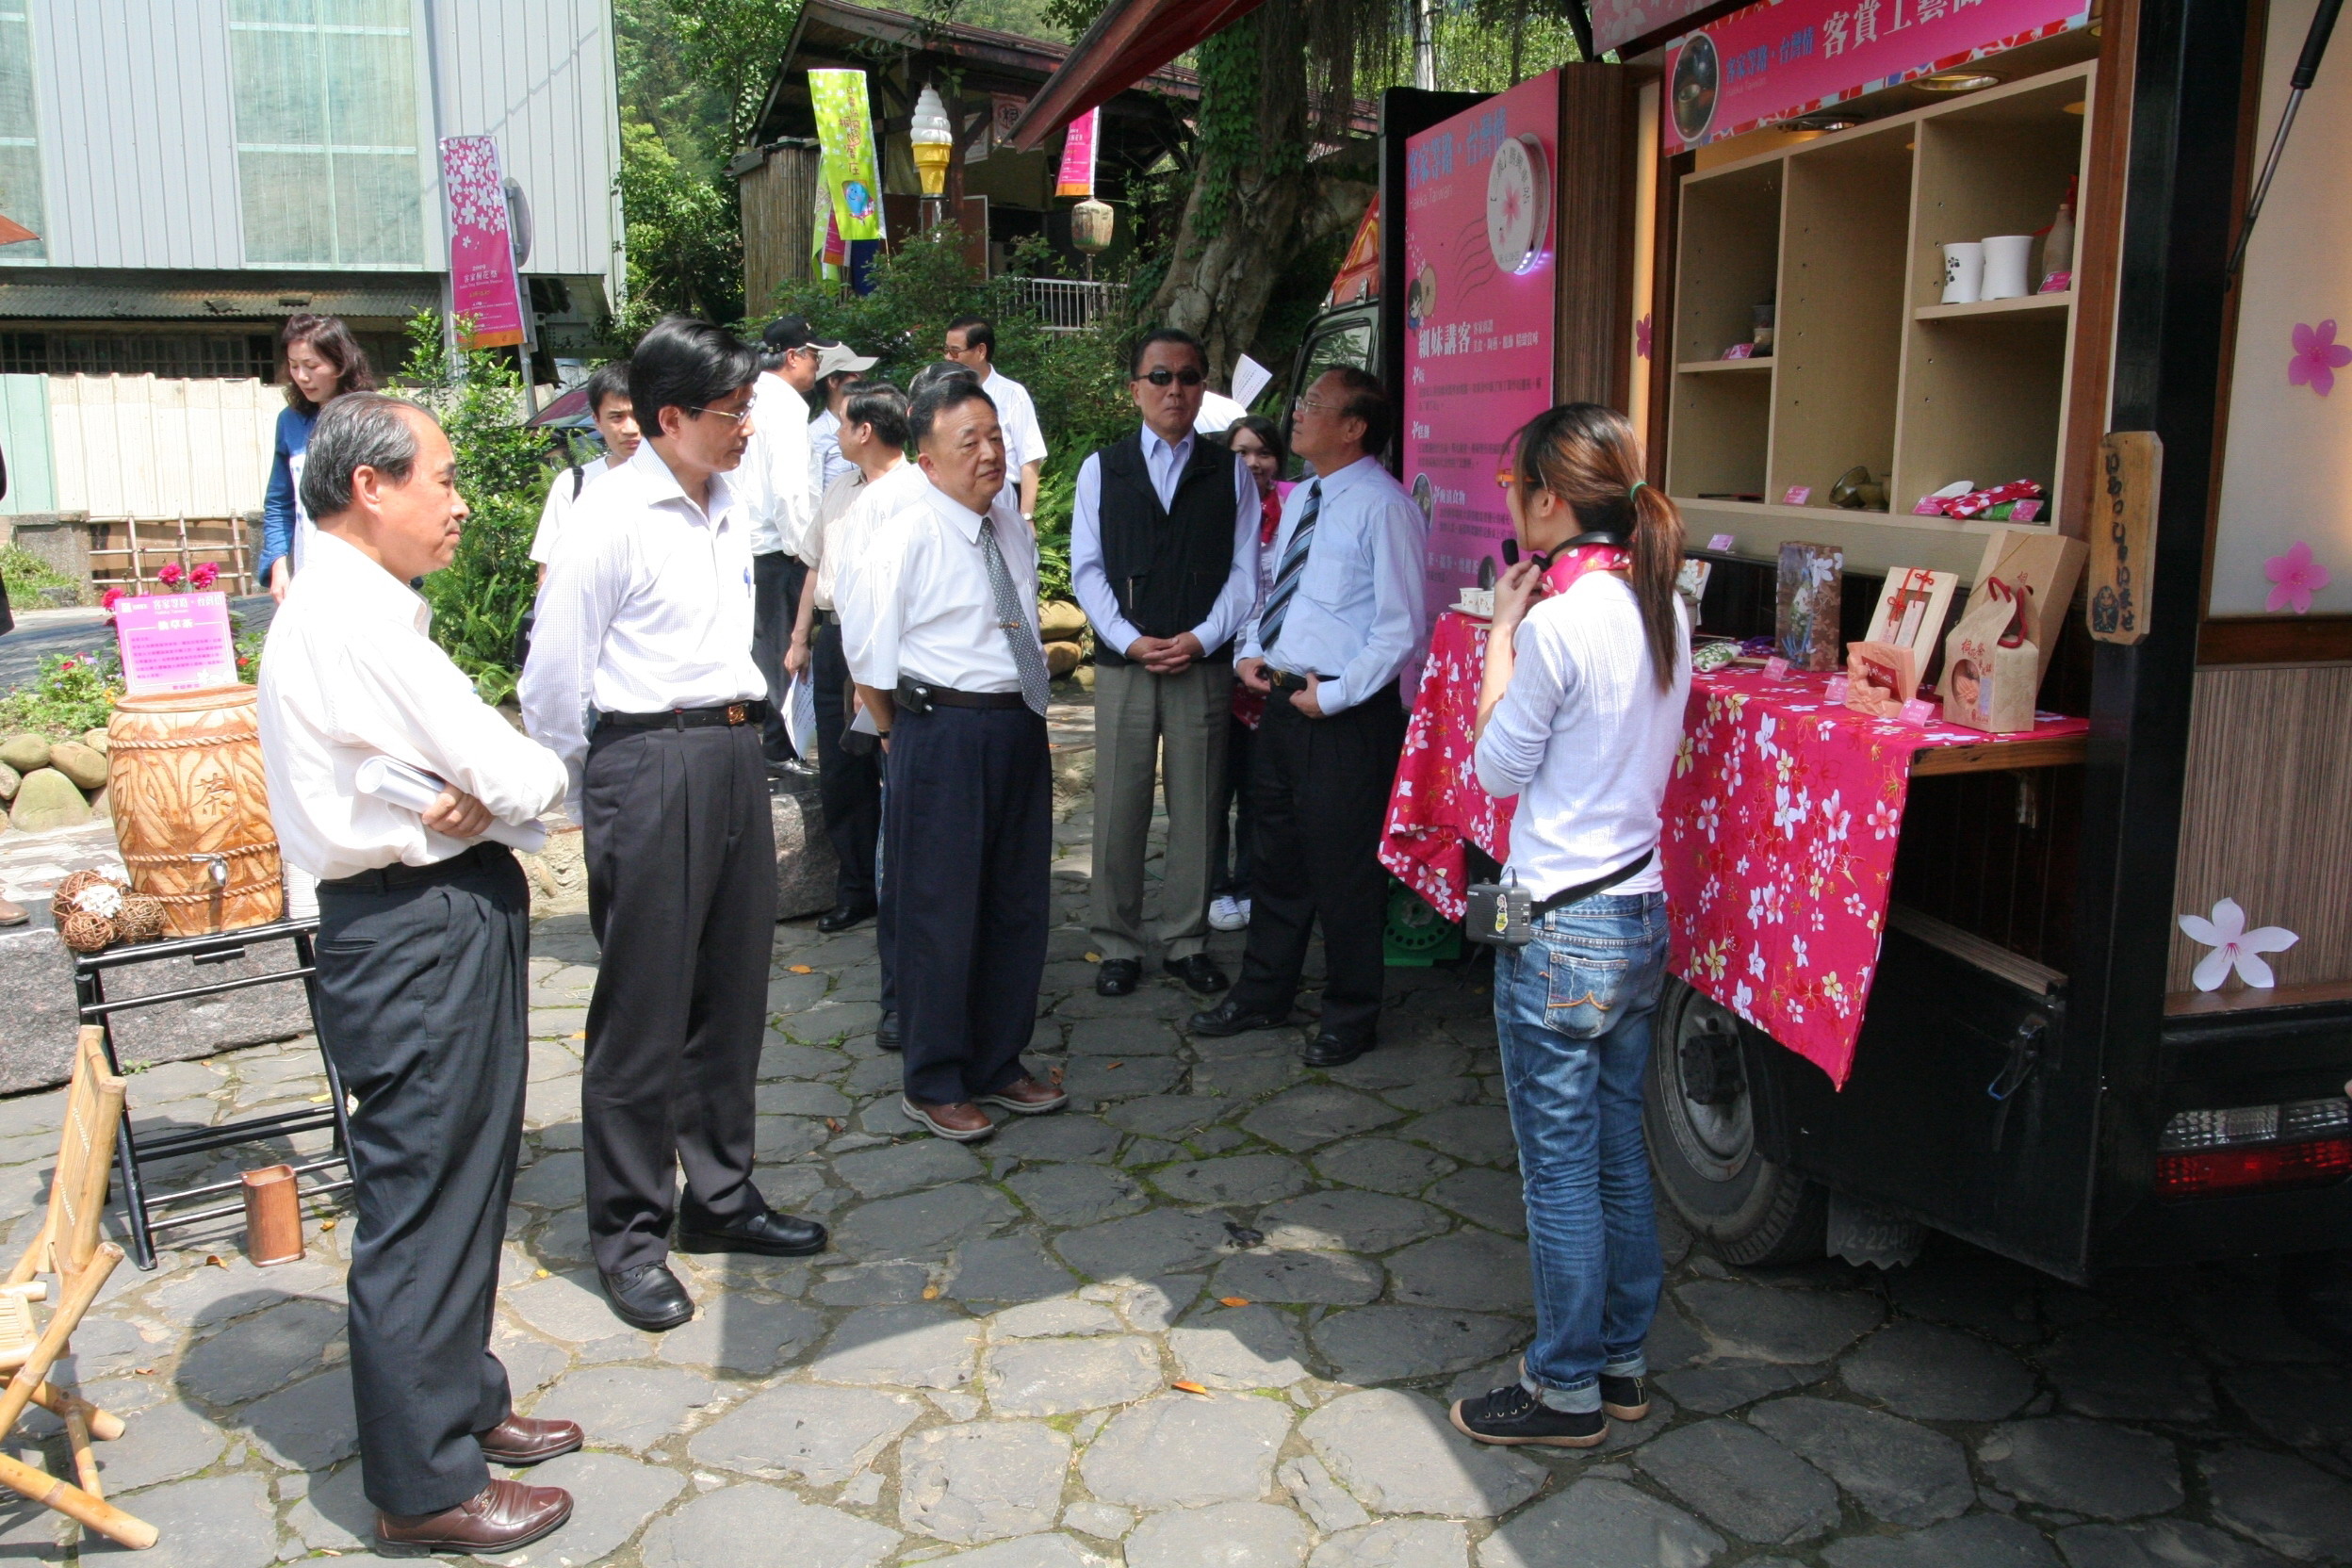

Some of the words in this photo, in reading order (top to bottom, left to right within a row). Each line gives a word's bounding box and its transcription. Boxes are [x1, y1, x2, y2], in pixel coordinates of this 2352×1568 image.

[1409, 192, 1428, 211] Hakka
[1429, 185, 1453, 203] Taiwan
[1418, 321, 1471, 358] 細妹講客
[191, 772, 233, 817] 茶
